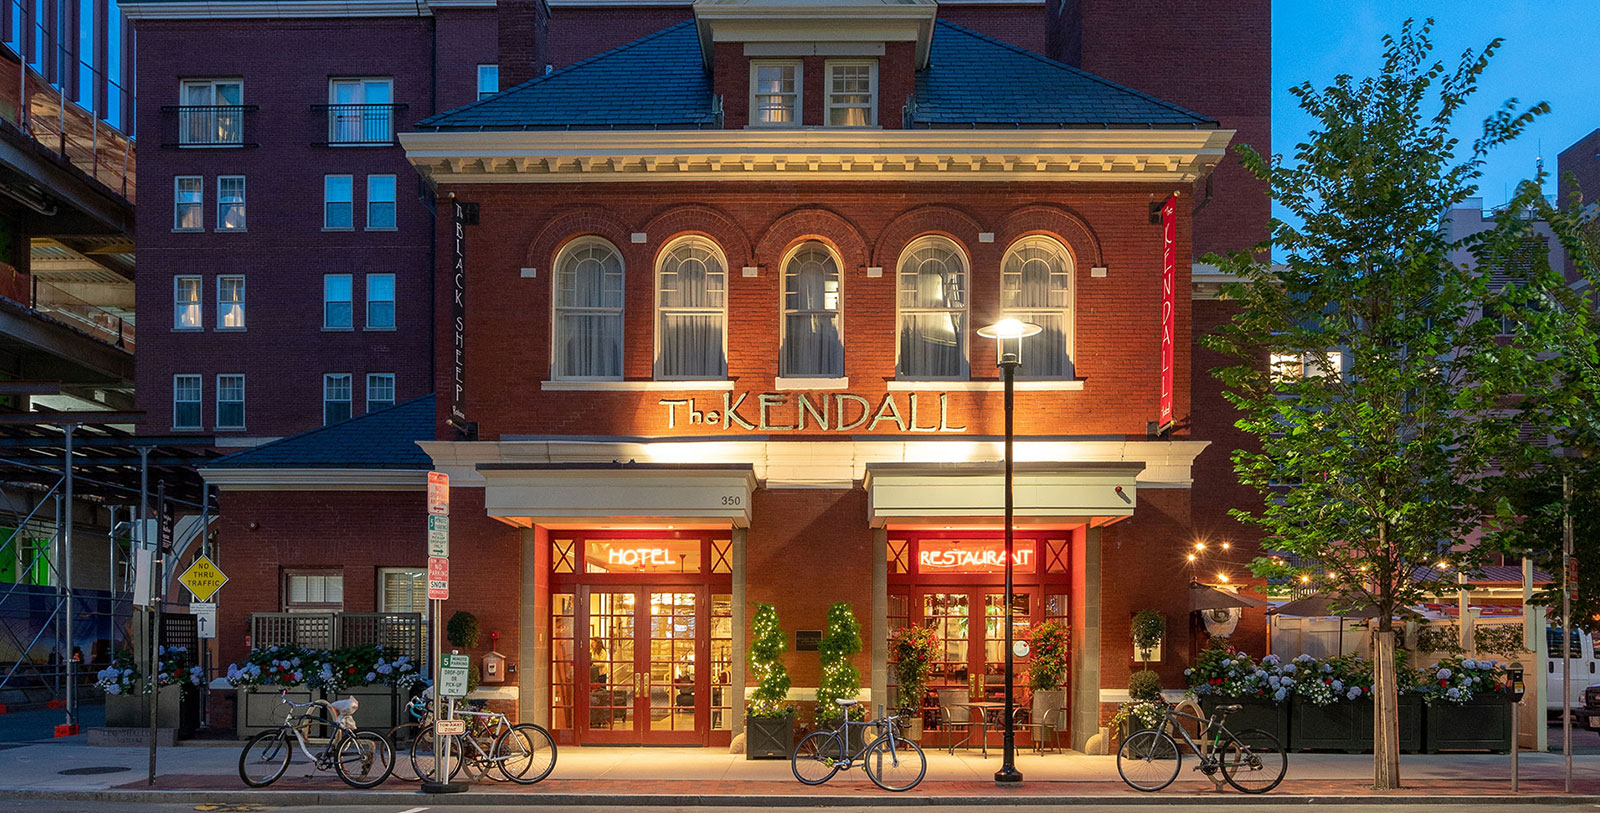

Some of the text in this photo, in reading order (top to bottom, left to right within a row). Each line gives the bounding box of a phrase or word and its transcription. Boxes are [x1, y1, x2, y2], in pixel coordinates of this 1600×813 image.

[455, 222, 464, 308] BLACK
[1162, 223, 1172, 398] KENDALL
[455, 316, 464, 401] SHEEP
[658, 391, 967, 432] The KENDALL
[721, 495, 741, 506] 350
[430, 518, 434, 528] 5
[608, 548, 676, 565] HOTEL
[920, 549, 1033, 566] RESTAURANT
[443, 657, 449, 665] 5
